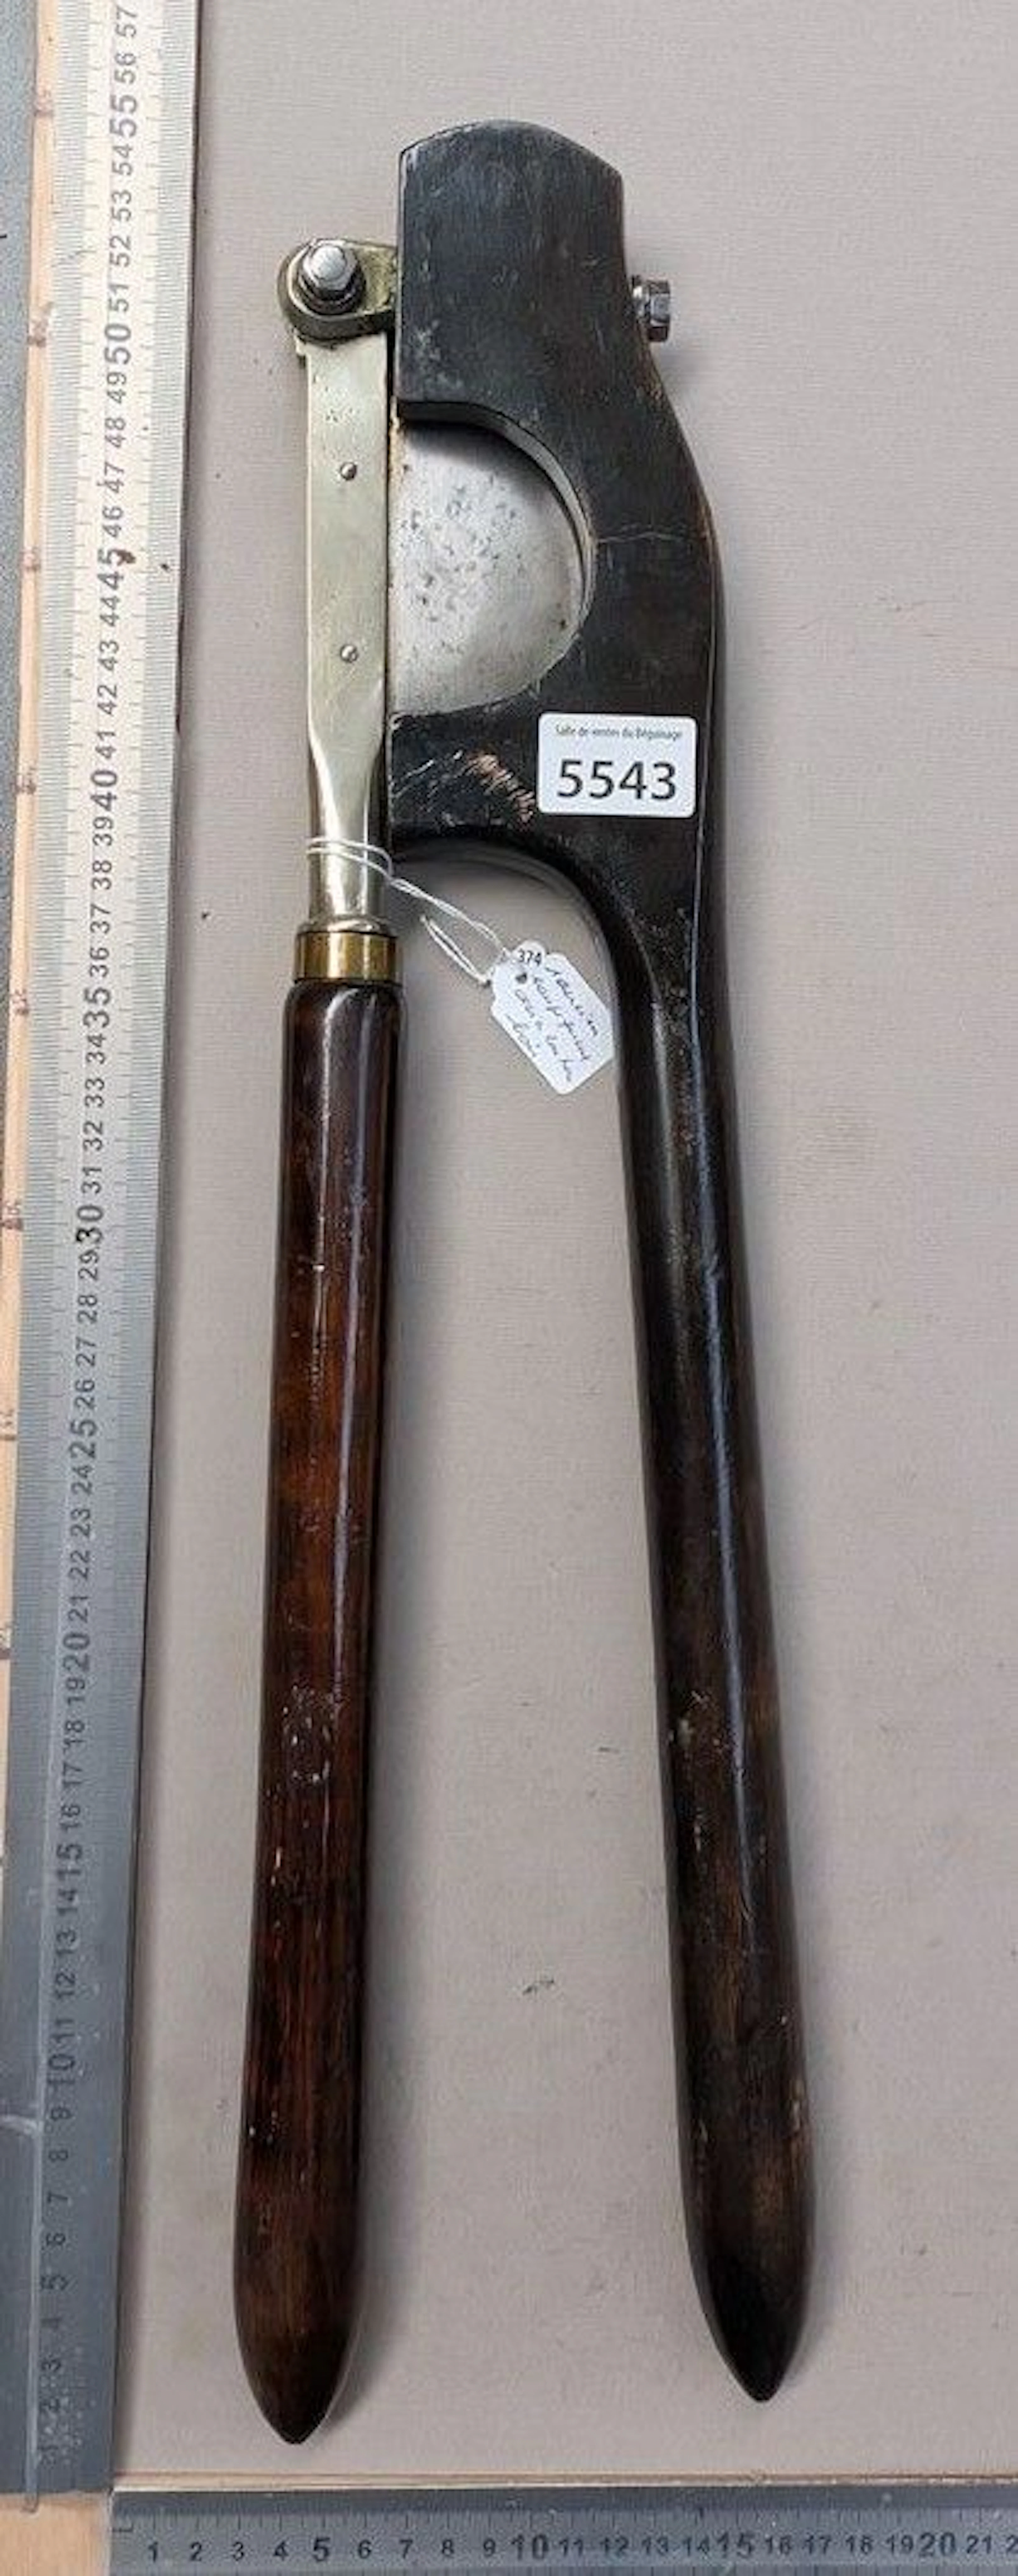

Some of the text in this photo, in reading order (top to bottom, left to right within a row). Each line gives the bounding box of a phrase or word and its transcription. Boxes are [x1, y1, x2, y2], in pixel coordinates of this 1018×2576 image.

[115, 5, 137, 37] 57
[114, 53, 136, 84] 56
[110, 95, 137, 138] 55
[112, 145, 133, 176] 54
[111, 191, 132, 222] 53
[110, 236, 130, 267] 52
[108, 285, 129, 313] 51
[104, 324, 132, 365] 50
[107, 372, 127, 404] 49
[105, 418, 126, 448] 48
[104, 462, 124, 493] 47
[103, 506, 123, 539] 46
[98, 548, 124, 590] 45
[100, 596, 121, 627] 44
[99, 640, 119, 671] 43
[98, 684, 117, 715] 42
[95, 731, 116, 759] 41
[555, 724, 575, 736] Salle
[579, 726, 588, 736] de
[593, 727, 620, 737] ventes
[622, 727, 633, 737] du
[91, 770, 118, 811] 40
[557, 758, 676, 799] 5543
[93, 817, 114, 846] 39
[92, 860, 112, 890] 38
[91, 903, 111, 934] 37
[90, 947, 110, 978] 36
[518, 949, 542, 966] 374
[83, 987, 111, 1028] 35
[86, 1033, 107, 1065] 34
[85, 1078, 105, 1108] 33
[83, 1121, 104, 1152] 32
[81, 1166, 102, 1194] 31
[76, 1204, 104, 1244] 30
[78, 1249, 99, 1281] 29
[77, 1294, 98, 1324] 28
[76, 1337, 96, 1367] 27
[74, 1379, 95, 1411] 26
[69, 1419, 98, 1460] 25
[71, 1464, 93, 1495] 24
[71, 1508, 91, 1538] 23
[69, 1550, 90, 1581] 22
[68, 1596, 89, 1624] 21
[63, 1634, 91, 1671] 20
[66, 1678, 85, 1706] 19
[64, 1719, 85, 1749] 18
[63, 1763, 83, 1787] 17
[61, 1804, 80, 1831] 16
[57, 1843, 83, 1878] 15
[58, 1889, 78, 1915] 14
[57, 1929, 76, 1958] 13
[55, 1972, 75, 1999] 12
[52, 2018, 74, 2042] 11
[47, 2053, 75, 2085] 10
[51, 2106, 72, 2121] 9
[49, 2150, 68, 2163] 8
[47, 2191, 68, 2203] 7
[46, 2232, 66, 2246] 6
[148, 2542, 159, 2562] 1
[191, 2542, 202, 2562] 2
[232, 2541, 244, 2562] 3
[274, 2540, 289, 2561] 4
[313, 2537, 330, 2562] 5
[357, 2539, 372, 2559] 6
[398, 2539, 413, 2559] 7
[441, 2539, 455, 2557] 8
[484, 2539, 496, 2557] 9
[511, 2534, 549, 2560] 10
[558, 2538, 584, 2556] 11
[600, 2537, 629, 2557] 12
[641, 2537, 669, 2556] 13
[682, 2537, 710, 2556] 14
[717, 2533, 755, 2559] 15
[765, 2536, 793, 2556] 16
[804, 2535, 832, 2555] 17
[846, 2536, 874, 2555] 18
[885, 2535, 915, 2554] 19
[920, 2532, 956, 2557] 20
[966, 2535, 992, 2554] 21
